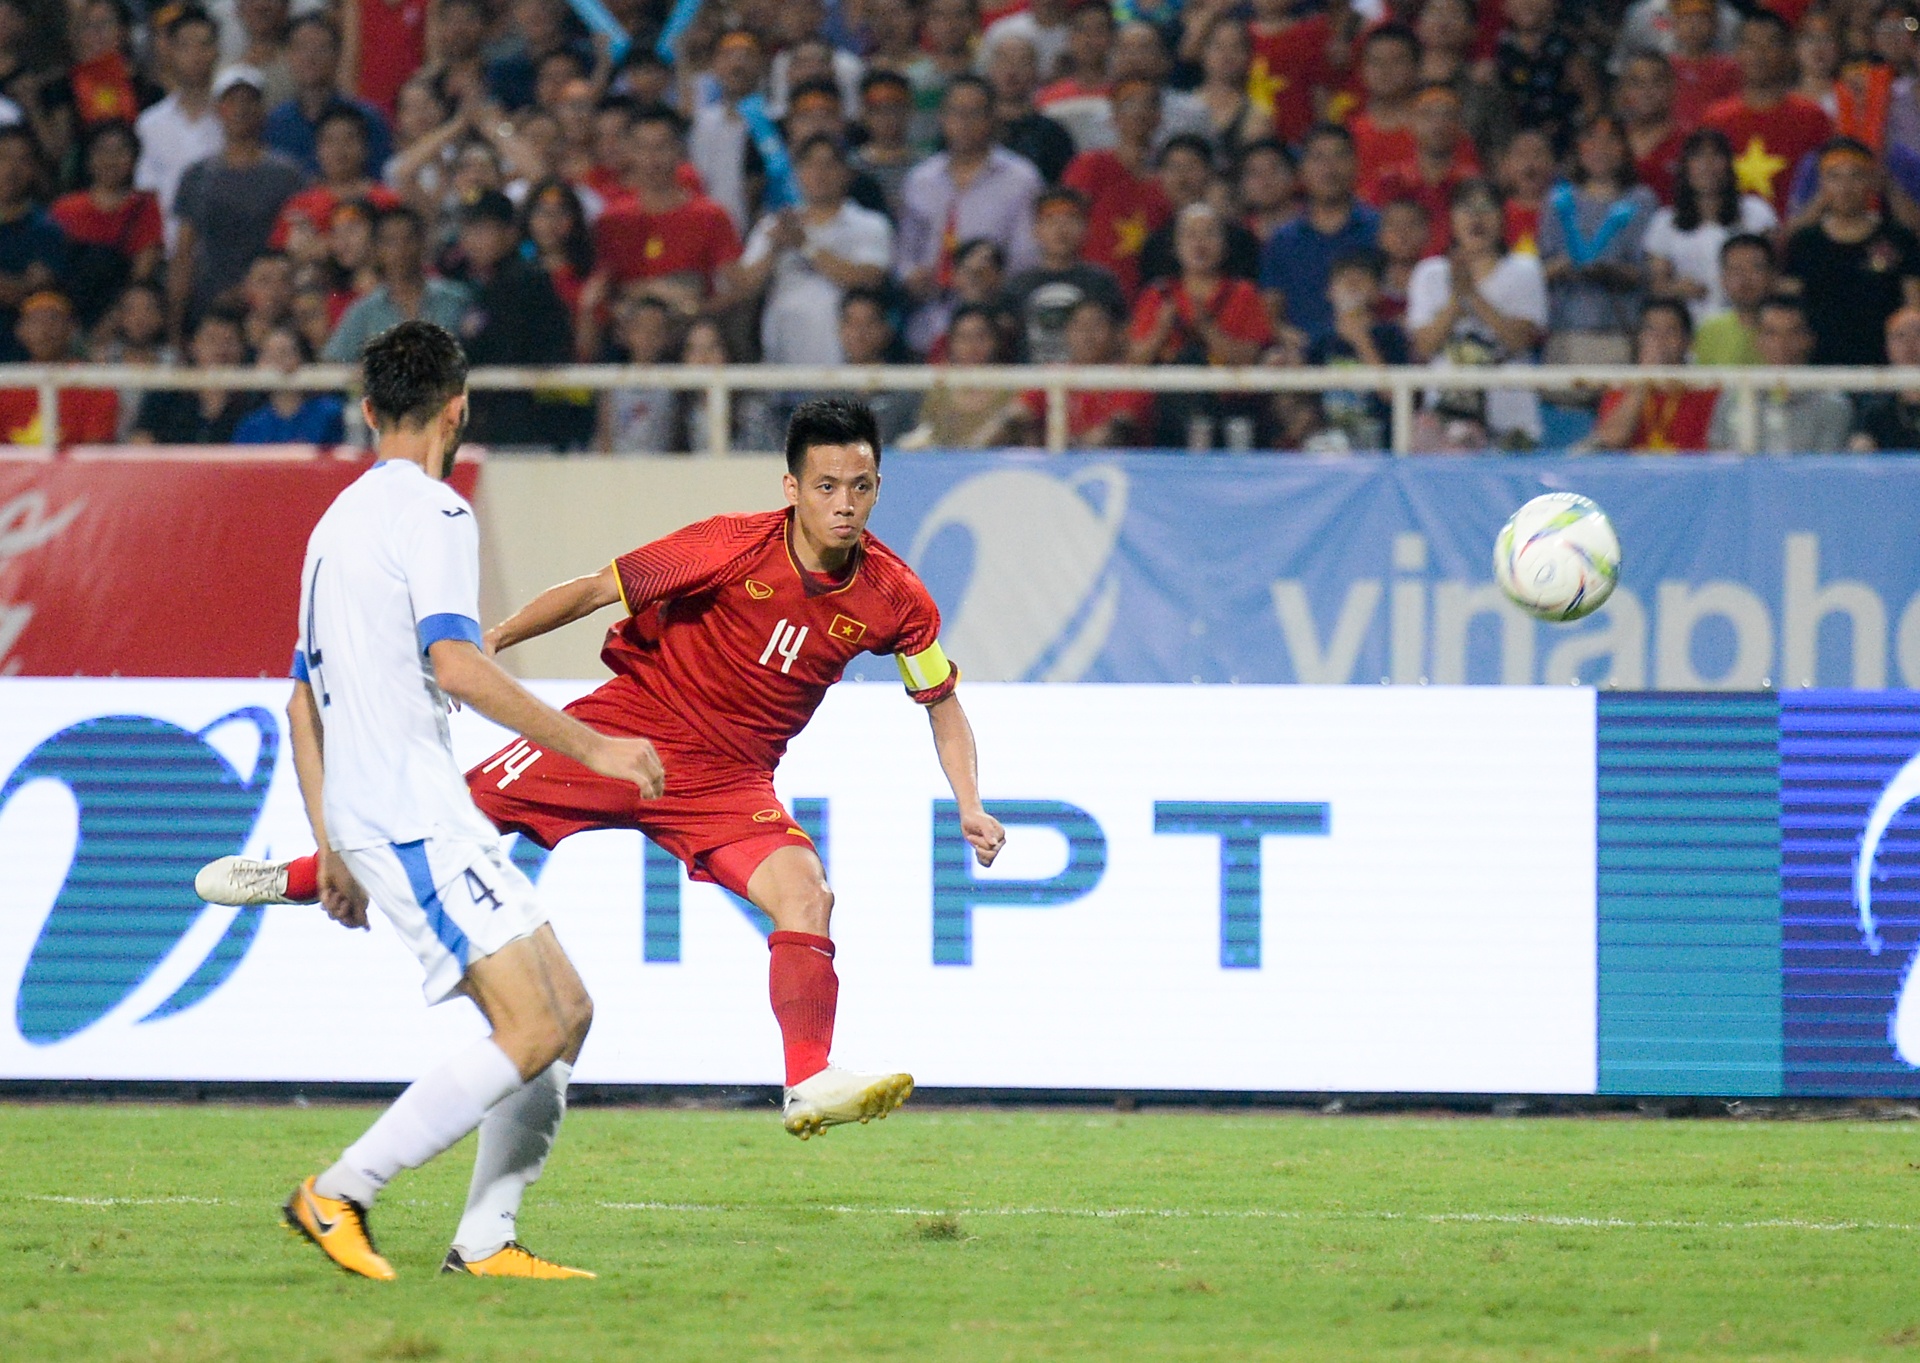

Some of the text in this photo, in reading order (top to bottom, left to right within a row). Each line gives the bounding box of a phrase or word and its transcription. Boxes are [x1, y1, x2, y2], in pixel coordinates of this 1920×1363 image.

[1271, 533, 1920, 690] vinaph
[758, 618, 809, 674] 14
[482, 739, 543, 790] 14
[463, 867, 504, 911] 4
